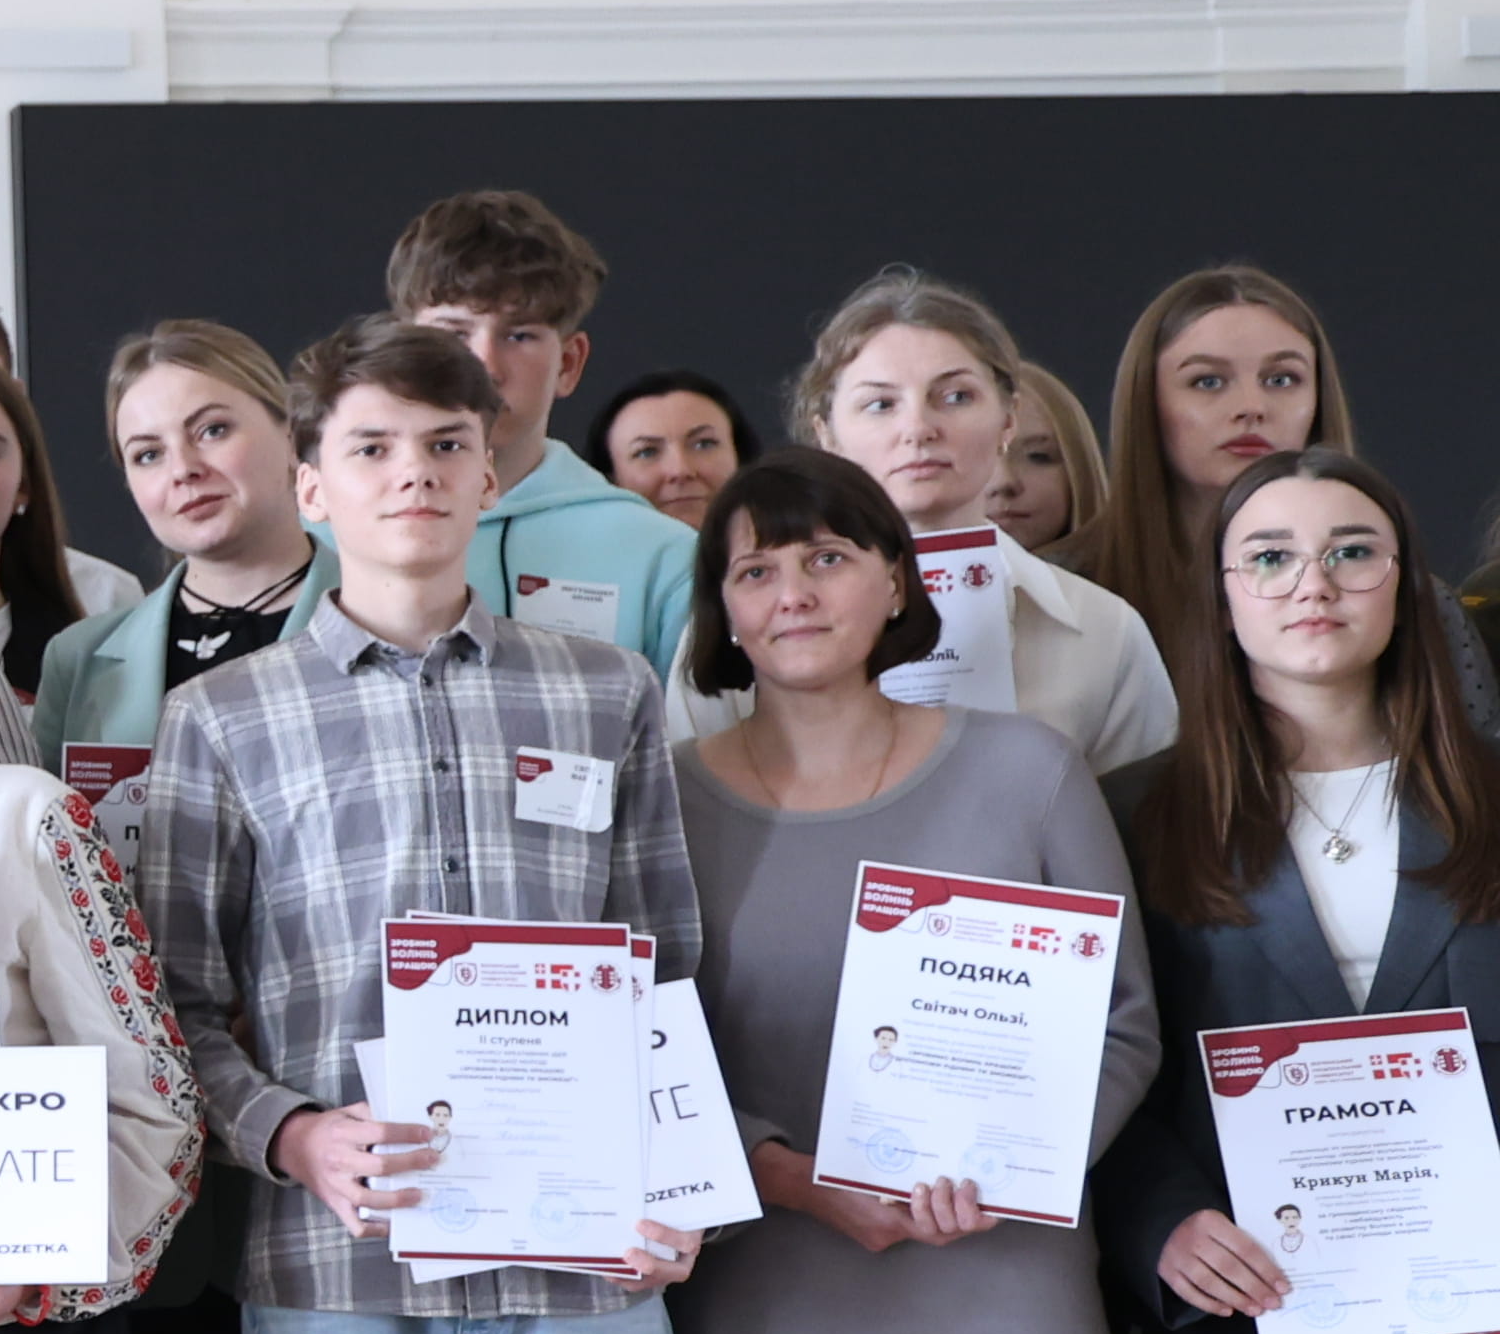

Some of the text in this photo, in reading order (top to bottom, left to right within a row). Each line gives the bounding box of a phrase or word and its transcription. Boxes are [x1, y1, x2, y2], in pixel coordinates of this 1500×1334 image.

[920, 957, 1032, 987] ПОДЯКА
[455, 1007, 570, 1027] ДИПЛОМ
[911, 998, 968, 1017] Світач
[490, 1036, 543, 1048] ступеня
[1284, 1099, 1417, 1125] ГРАМОТА
[1292, 1166, 1440, 1191] Крикун Марія,
[644, 1181, 716, 1204] OZETKA
